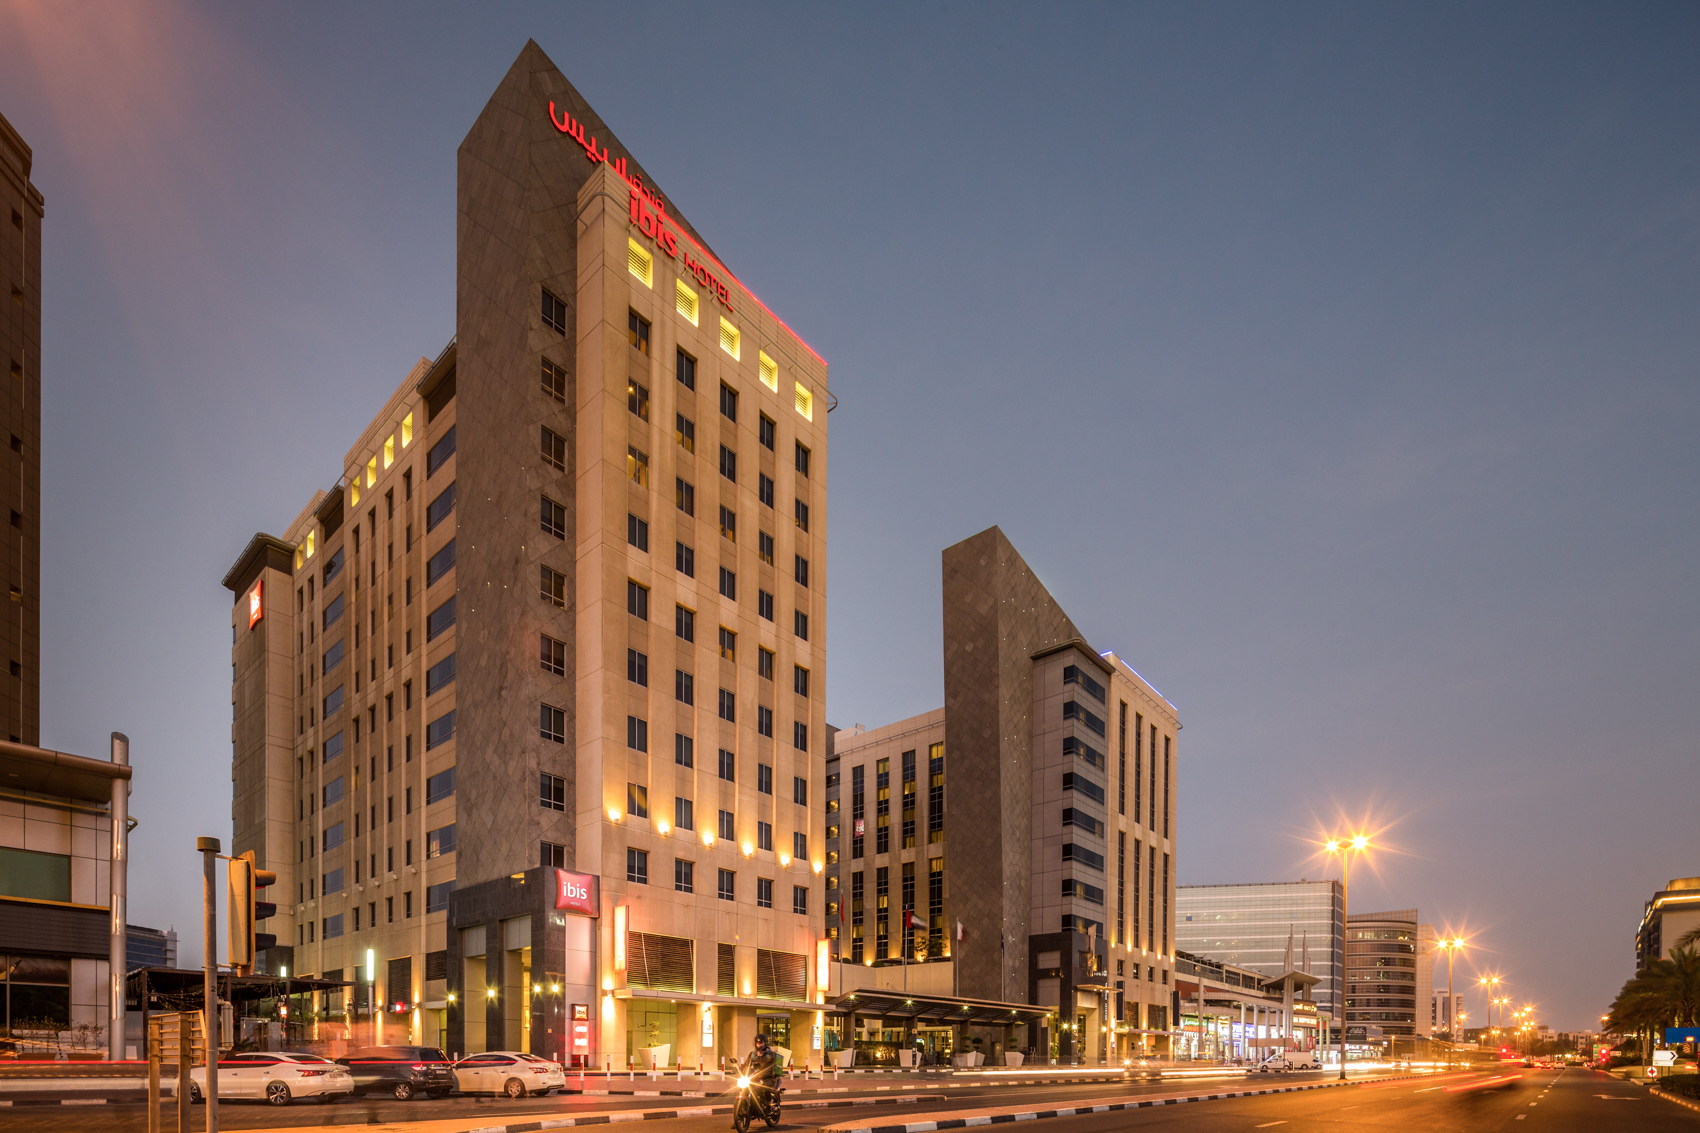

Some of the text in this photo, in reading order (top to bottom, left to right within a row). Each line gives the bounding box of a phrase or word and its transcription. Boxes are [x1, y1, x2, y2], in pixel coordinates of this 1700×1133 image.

[630, 190, 734, 312] ibis HOTEL
[563, 881, 587, 900] ibis
